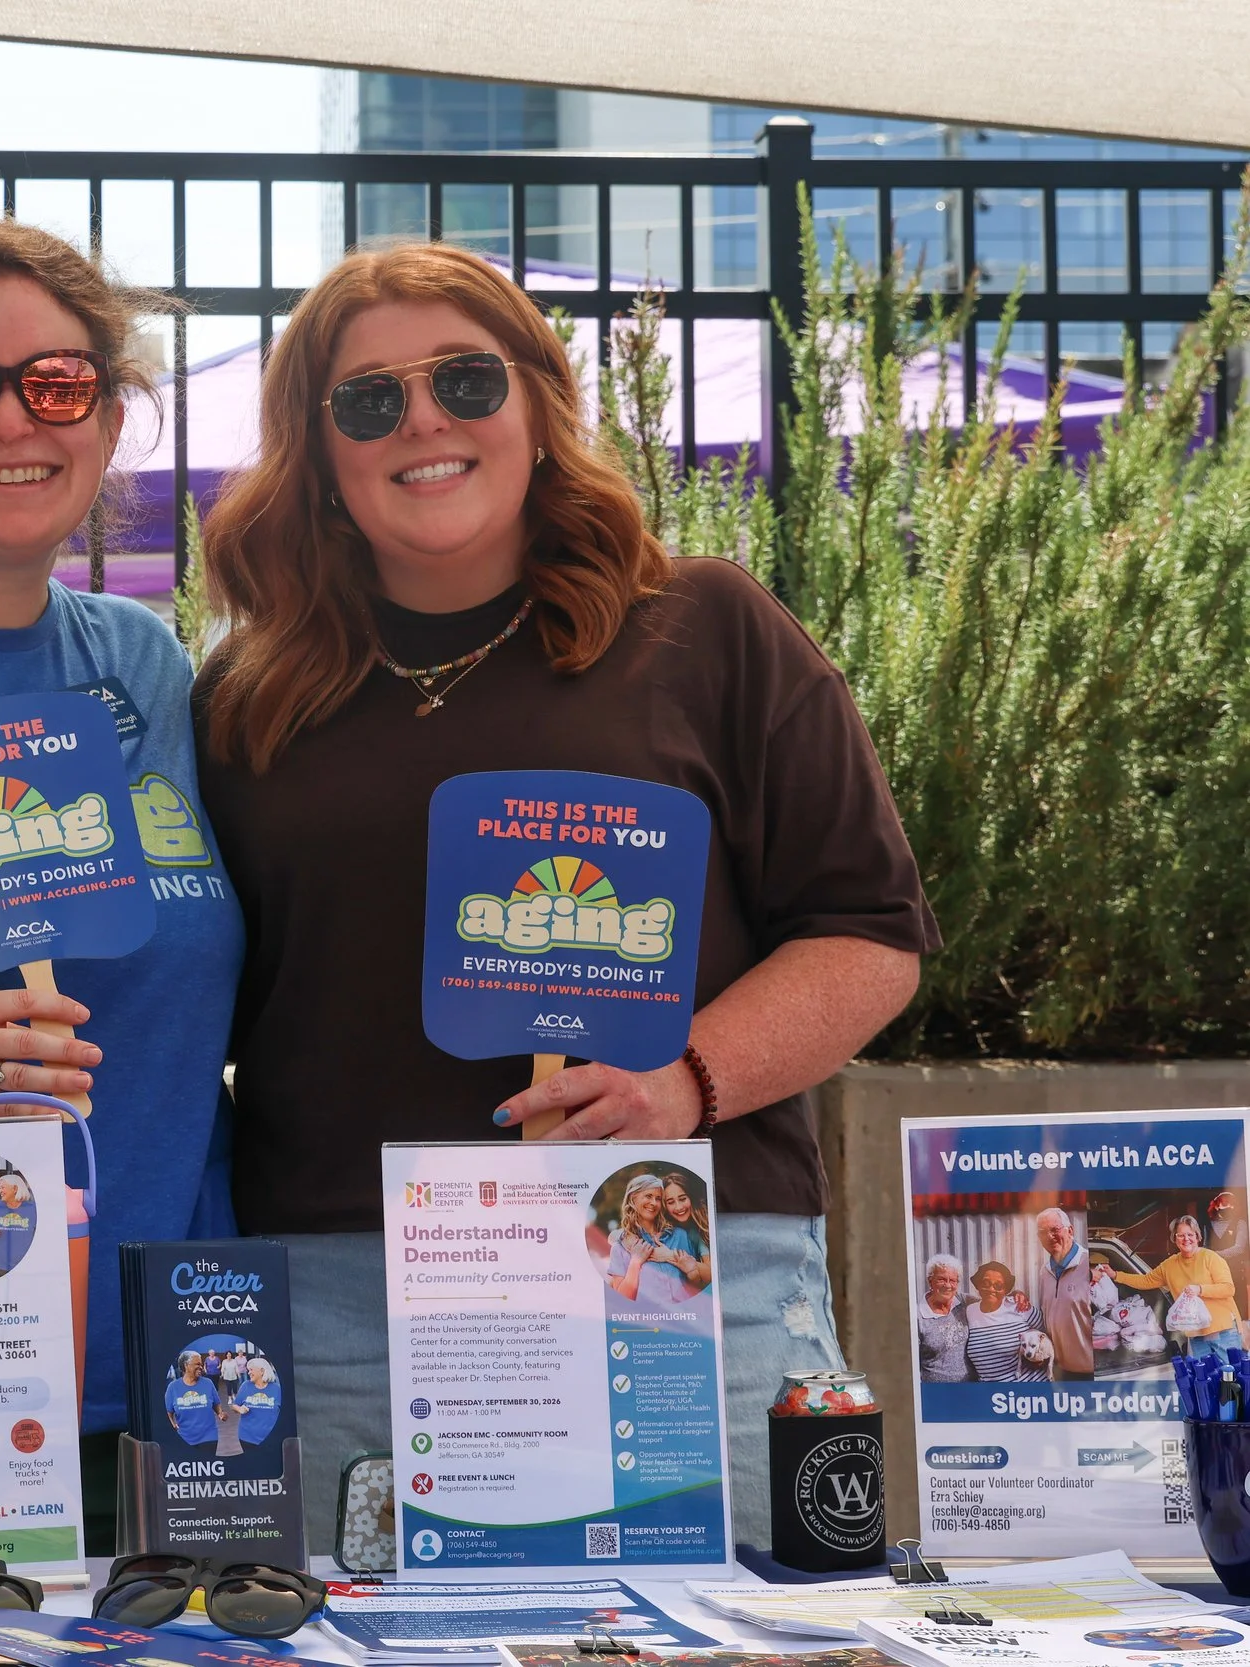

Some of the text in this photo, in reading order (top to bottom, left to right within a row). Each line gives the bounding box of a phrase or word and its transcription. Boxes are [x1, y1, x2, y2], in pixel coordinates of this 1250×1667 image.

[0, 718, 45, 740] THE
[24, 733, 77, 756] YOU
[504, 799, 637, 824] THIS IS THE
[478, 819, 666, 848] PLACE FOR YOU
[41, 862, 96, 883] DOING
[100, 858, 114, 872] IT
[8, 876, 136, 906] WWW.ACCAGING.ORG
[151, 874, 227, 902] ING IT
[6, 920, 58, 940] ACCA
[461, 893, 671, 957] aging
[463, 957, 664, 983] EVERYBODY'S DOING IT
[442, 977, 679, 1002] (706) 549-4850 WWW.ACCAGING.ORG
[533, 1013, 584, 1029] ACCA
[939, 1144, 1214, 1173] Volunteer with ACCA
[403, 1223, 548, 1244] Understanding
[404, 1246, 498, 1263] Dementia
[196, 1260, 219, 1273] the
[171, 1262, 264, 1296] Center
[404, 1271, 571, 1285] A Community Conversation
[178, 1294, 258, 1313] at ACCA
[22, 1315, 39, 1324] PM
[612, 1312, 696, 1322] EVENT HIGHLIGHTS
[5, 1350, 36, 1359] 30601
[992, 1391, 1180, 1420] Sign Up Today!
[929, 1450, 1005, 1465] Questions?
[1082, 1452, 1132, 1463] SCAN ME
[165, 1460, 224, 1477] AGING
[800, 1439, 852, 1500] ROCKING
[167, 1478, 286, 1499] REIMAGINED.
[930, 1476, 1094, 1488] Contact our Volunteer Coordinator
[931, 1490, 984, 1503] Ezra Schley
[21, 1503, 64, 1516] LEARN
[932, 1505, 1045, 1519] (eschley@accaging.org)
[168, 1515, 274, 1527] Connection. Support.
[932, 1518, 1010, 1532] (706)-549-4850
[169, 1528, 282, 1542] Possibility. It's all here.
